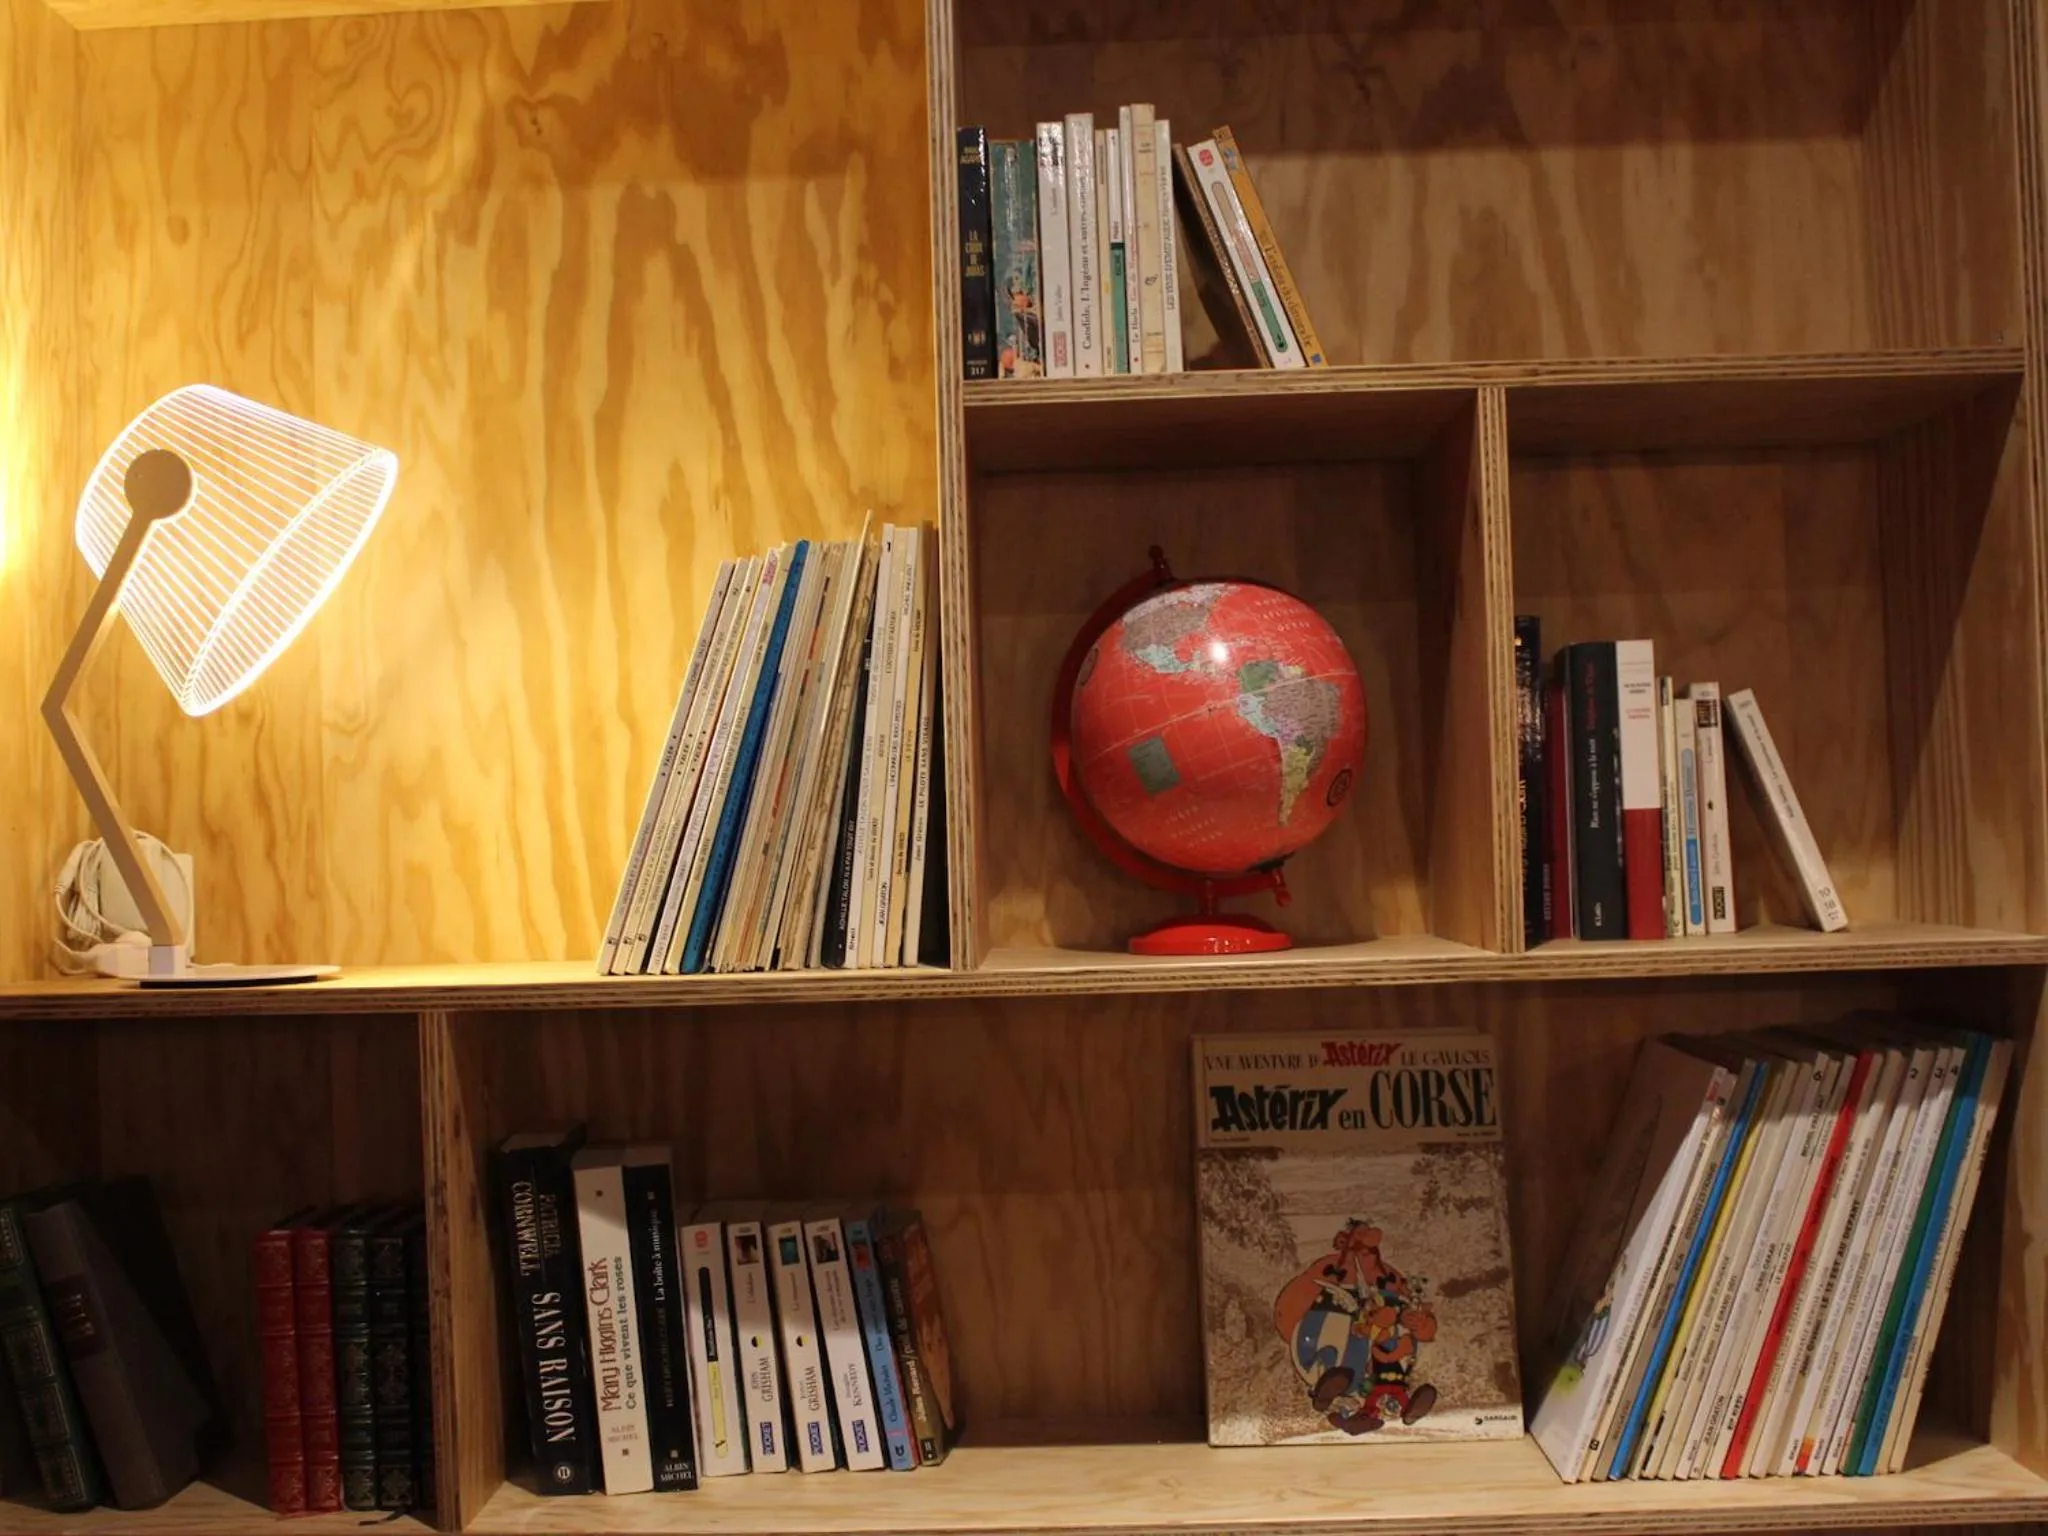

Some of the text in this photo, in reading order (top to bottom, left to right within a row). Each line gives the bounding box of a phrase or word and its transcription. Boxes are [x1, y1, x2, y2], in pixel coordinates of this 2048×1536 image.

[919, 746, 927, 768] SANS
[917, 770, 926, 796] PILOTE
[917, 797, 924, 808] LE
[840, 878, 848, 901] TALON
[837, 901, 847, 930] ACHILLE
[1321, 1039, 1401, 1067] Astérix
[1209, 1067, 1497, 1132] Astérix en CORSE
[510, 1180, 540, 1276] CORNWELL
[652, 1287, 665, 1301] La
[530, 1291, 566, 1349] SANS
[587, 1258, 623, 1411] Mary Higgins Clark
[612, 1256, 638, 1409] Ce que vivent les roses
[756, 1356, 773, 1402] GRISHAM
[801, 1365, 820, 1412] GRISHAM
[536, 1358, 576, 1443] RAISON
[912, 1394, 927, 1423] Jules
